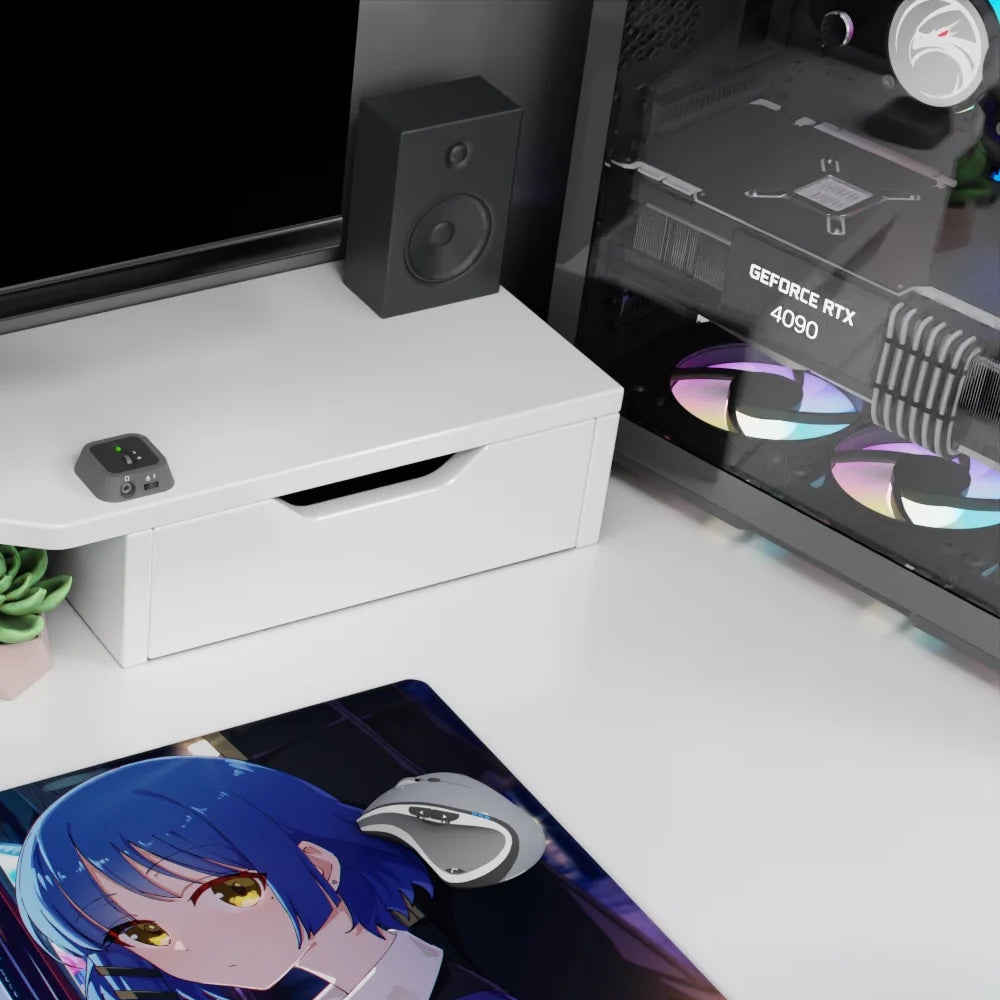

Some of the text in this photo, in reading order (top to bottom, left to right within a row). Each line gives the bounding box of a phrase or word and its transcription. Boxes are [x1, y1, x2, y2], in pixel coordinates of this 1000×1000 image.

[749, 263, 856, 327] GEFORCE RTX
[769, 305, 819, 340] 4090
